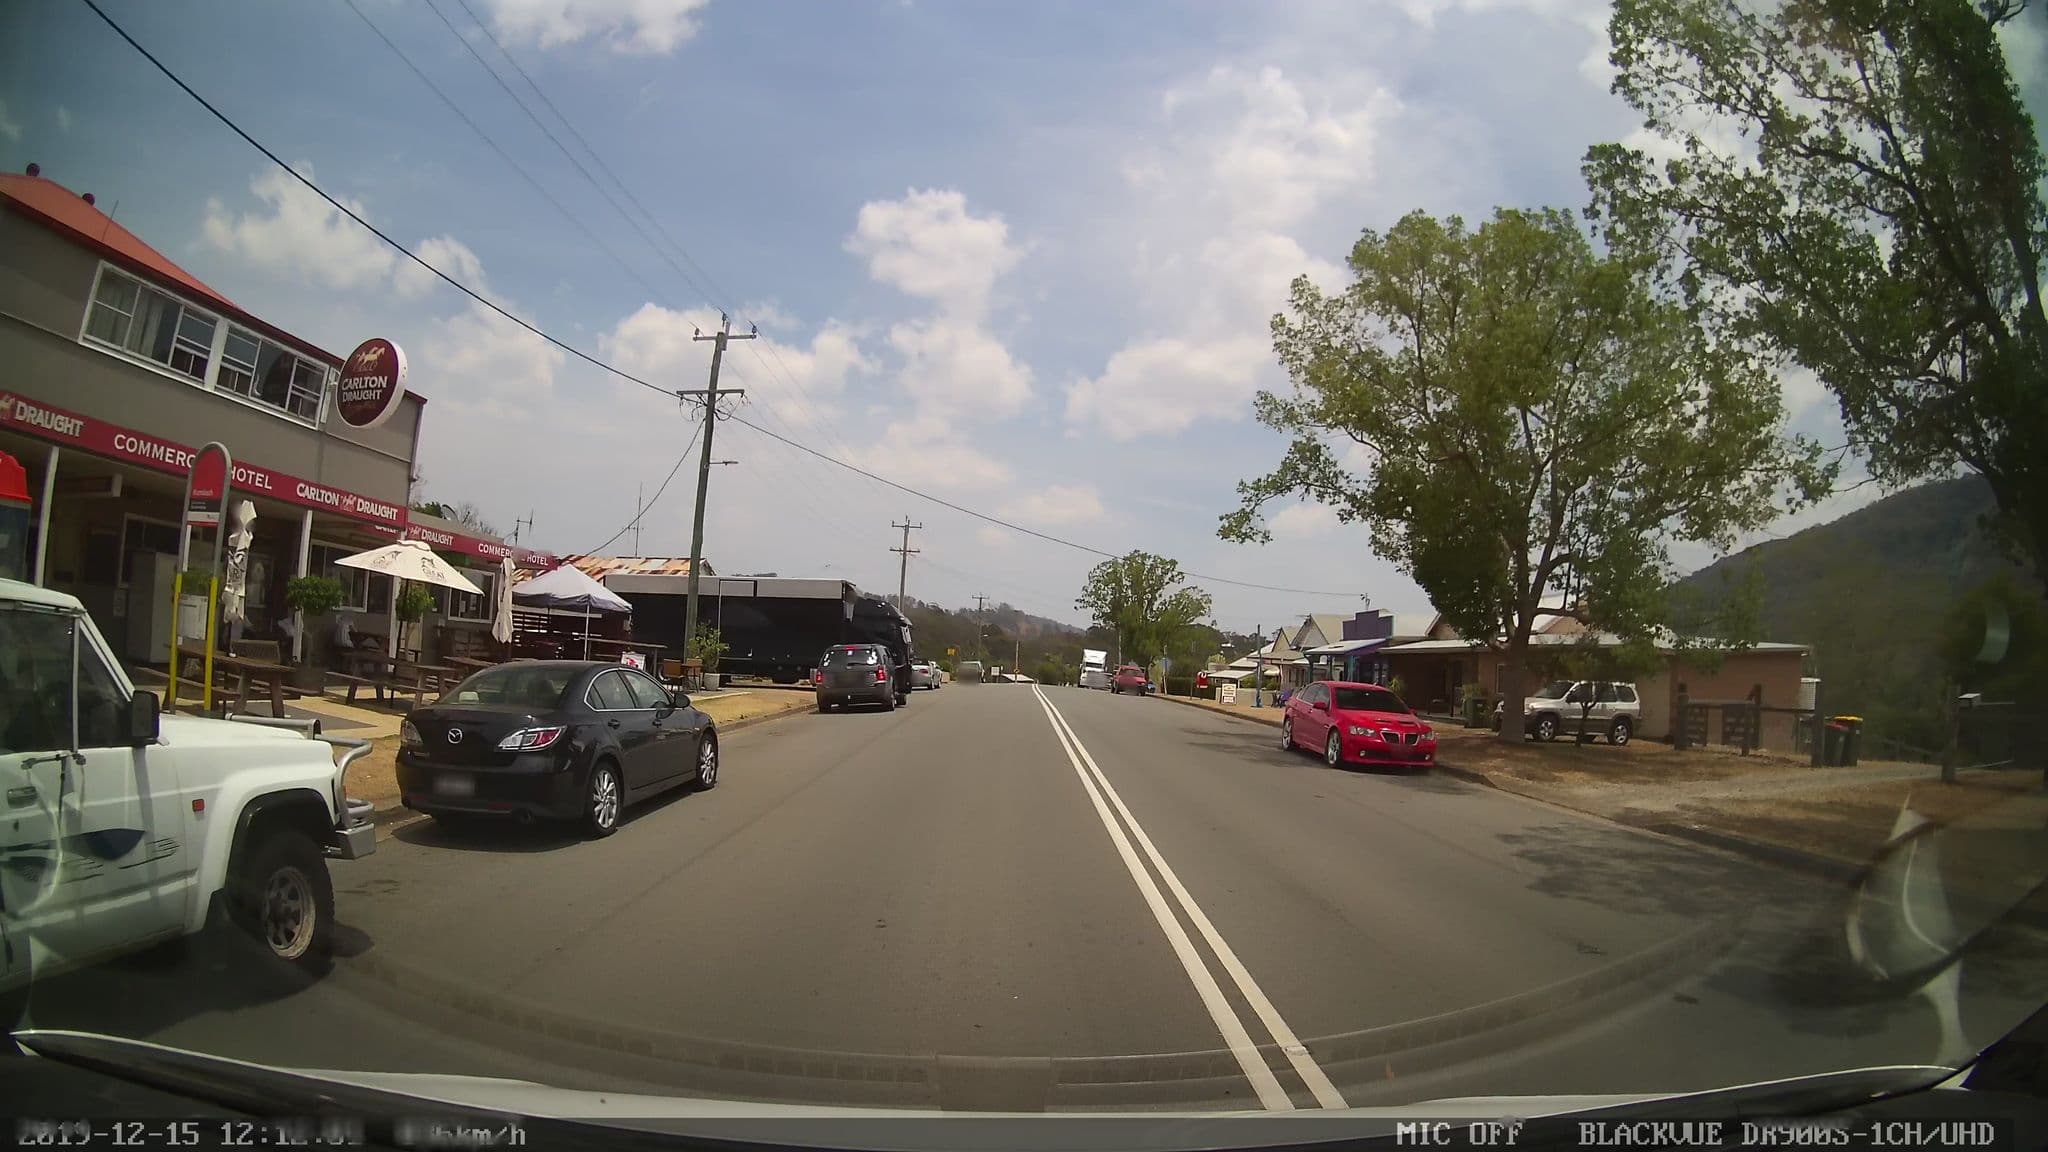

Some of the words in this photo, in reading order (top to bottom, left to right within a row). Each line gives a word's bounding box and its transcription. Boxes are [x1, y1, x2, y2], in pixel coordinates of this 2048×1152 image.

[342, 376, 388, 391] CARLTON
[342, 390, 382, 402] DRAUGHT
[15, 401, 84, 438] DRAUGHT
[114, 434, 196, 468] COMMERC
[296, 483, 341, 506] CARLTON
[356, 498, 398, 521] DRAUGHT
[421, 529, 454, 546] DRAUGHT
[478, 543, 517, 559] COMMERC
[526, 554, 549, 567] HOTEL
